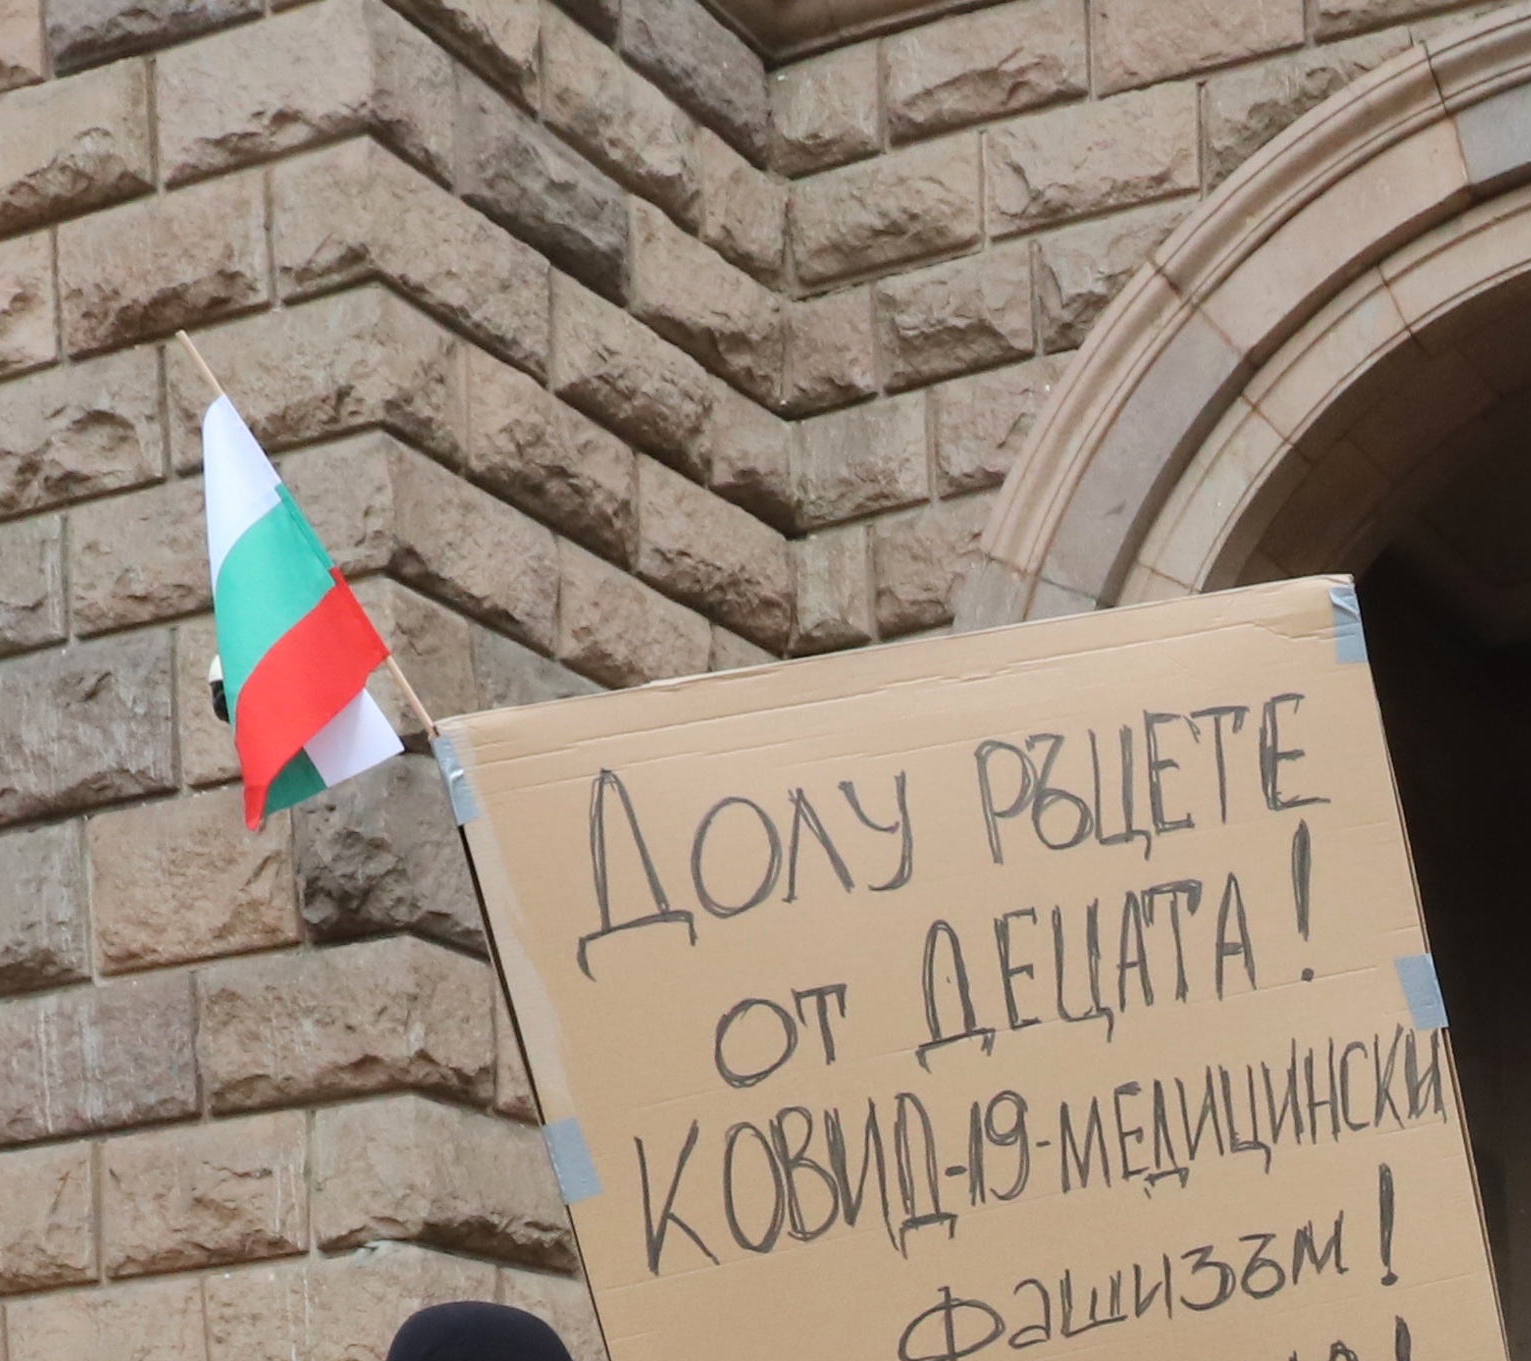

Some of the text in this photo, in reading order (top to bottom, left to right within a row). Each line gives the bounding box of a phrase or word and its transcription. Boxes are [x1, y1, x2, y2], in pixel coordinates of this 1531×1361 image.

[576, 692, 1331, 978] ДОЛУ РЪЦЕТЕ
[714, 984, 847, 1087] ОТ
